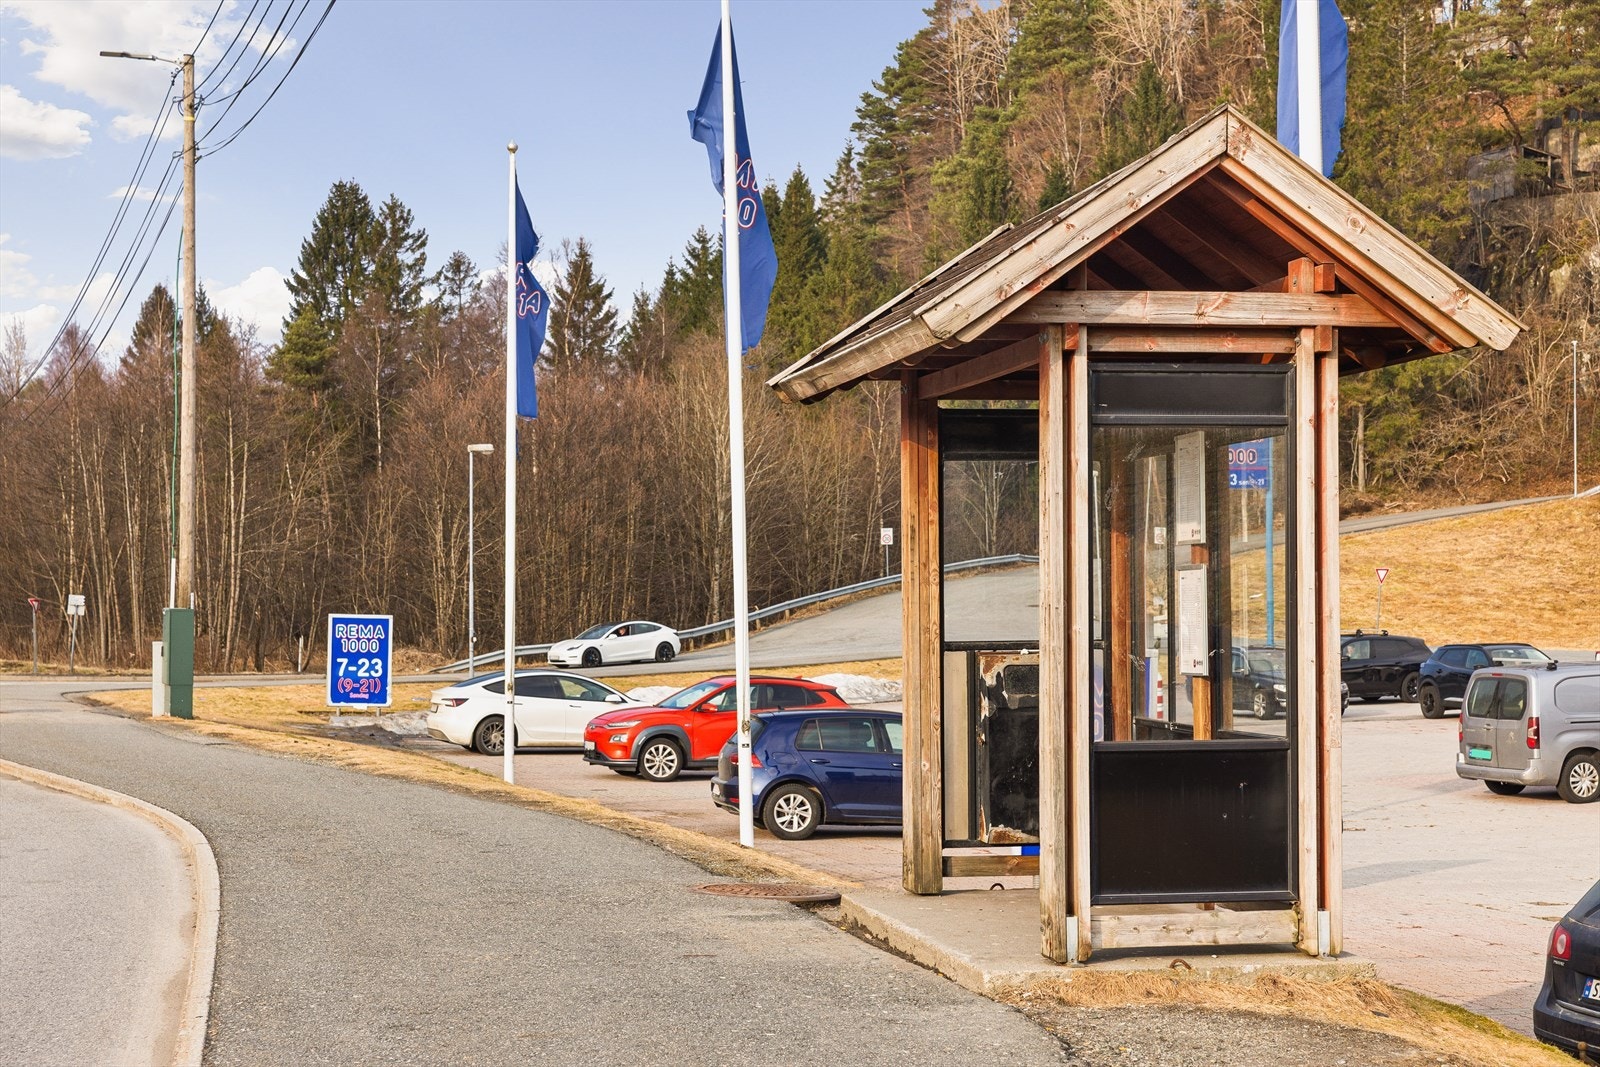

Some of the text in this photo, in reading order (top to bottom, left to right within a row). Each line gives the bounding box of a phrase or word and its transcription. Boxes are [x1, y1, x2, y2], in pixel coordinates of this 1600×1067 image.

[335, 624, 385, 639] REMA
[341, 638, 380, 653] 1000
[336, 658, 383, 678] 7-23
[337, 677, 382, 694] (9-21)
[1592, 981, 1600, 998] S
